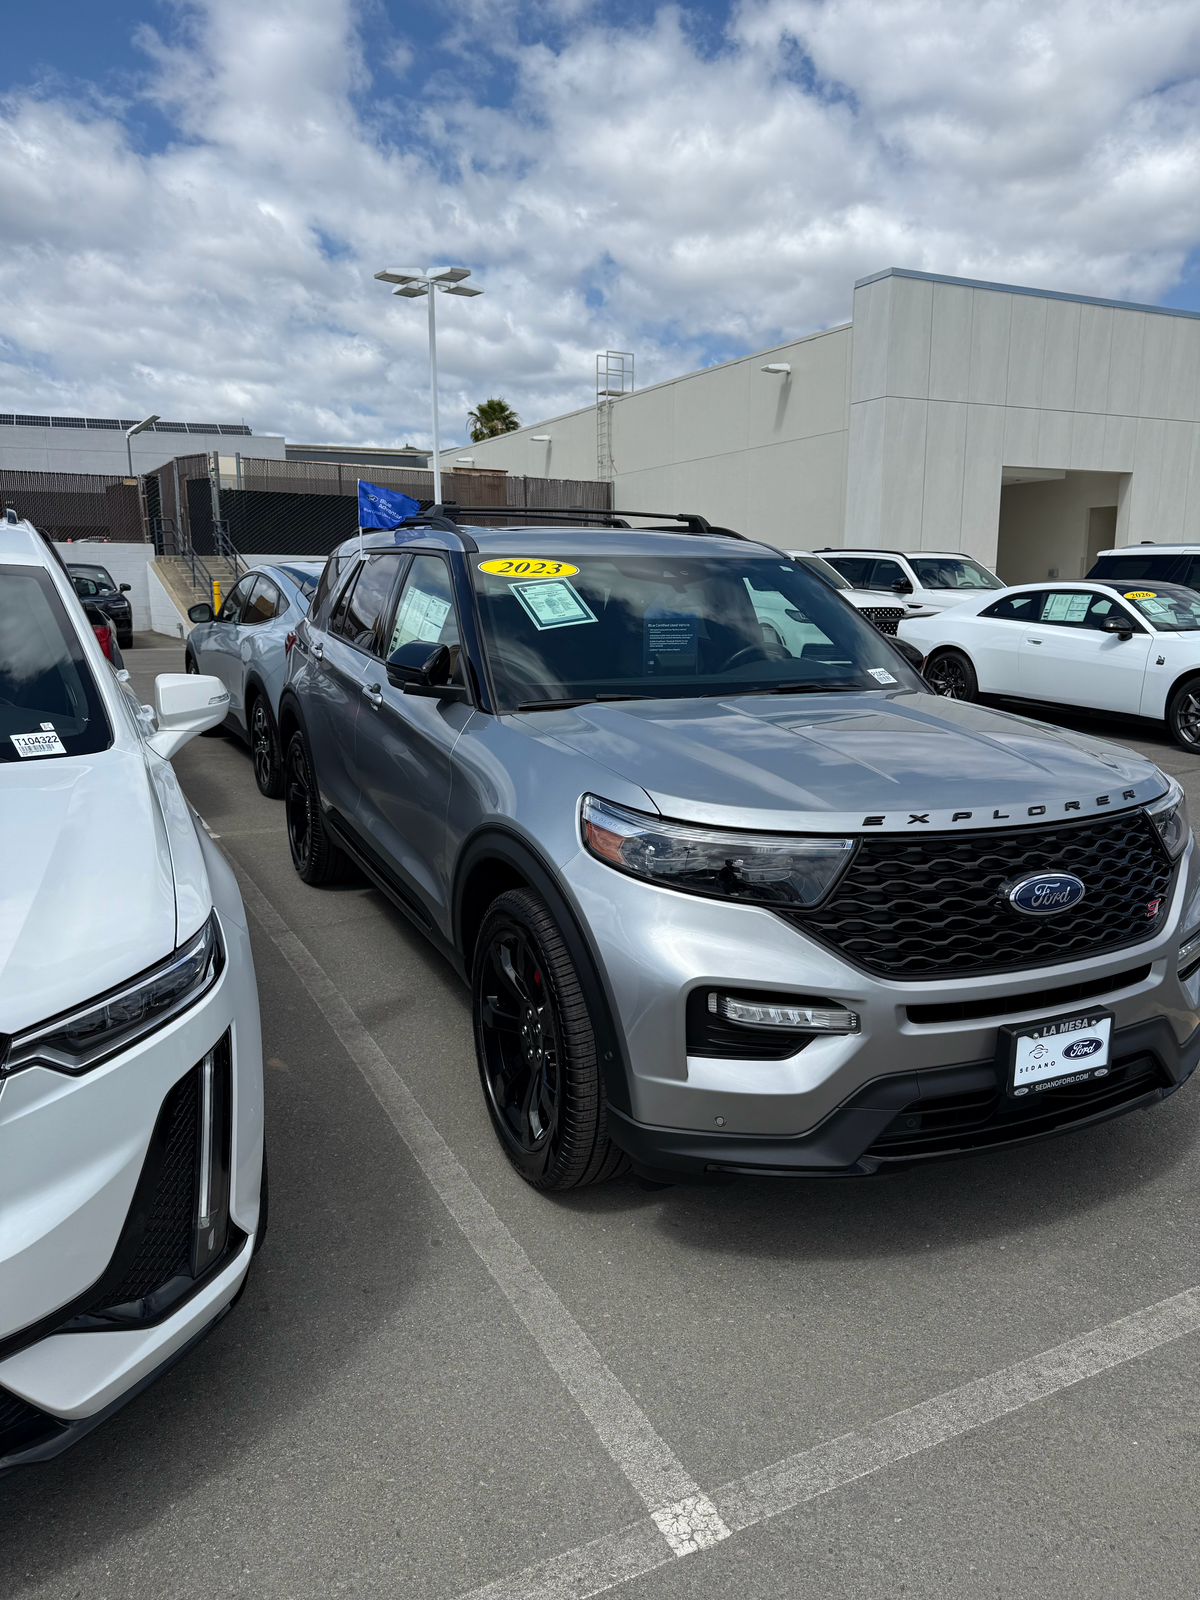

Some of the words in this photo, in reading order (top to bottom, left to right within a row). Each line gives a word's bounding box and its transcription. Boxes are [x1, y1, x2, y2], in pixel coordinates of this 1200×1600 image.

[496, 561, 563, 575] 2023
[14, 735, 60, 746] T104322
[862, 789, 1136, 827] EXPLORER
[1042, 1025, 1057, 1037] LA
[1060, 1018, 1089, 1033] MESA
[1019, 1060, 1056, 1074] SEDANO
